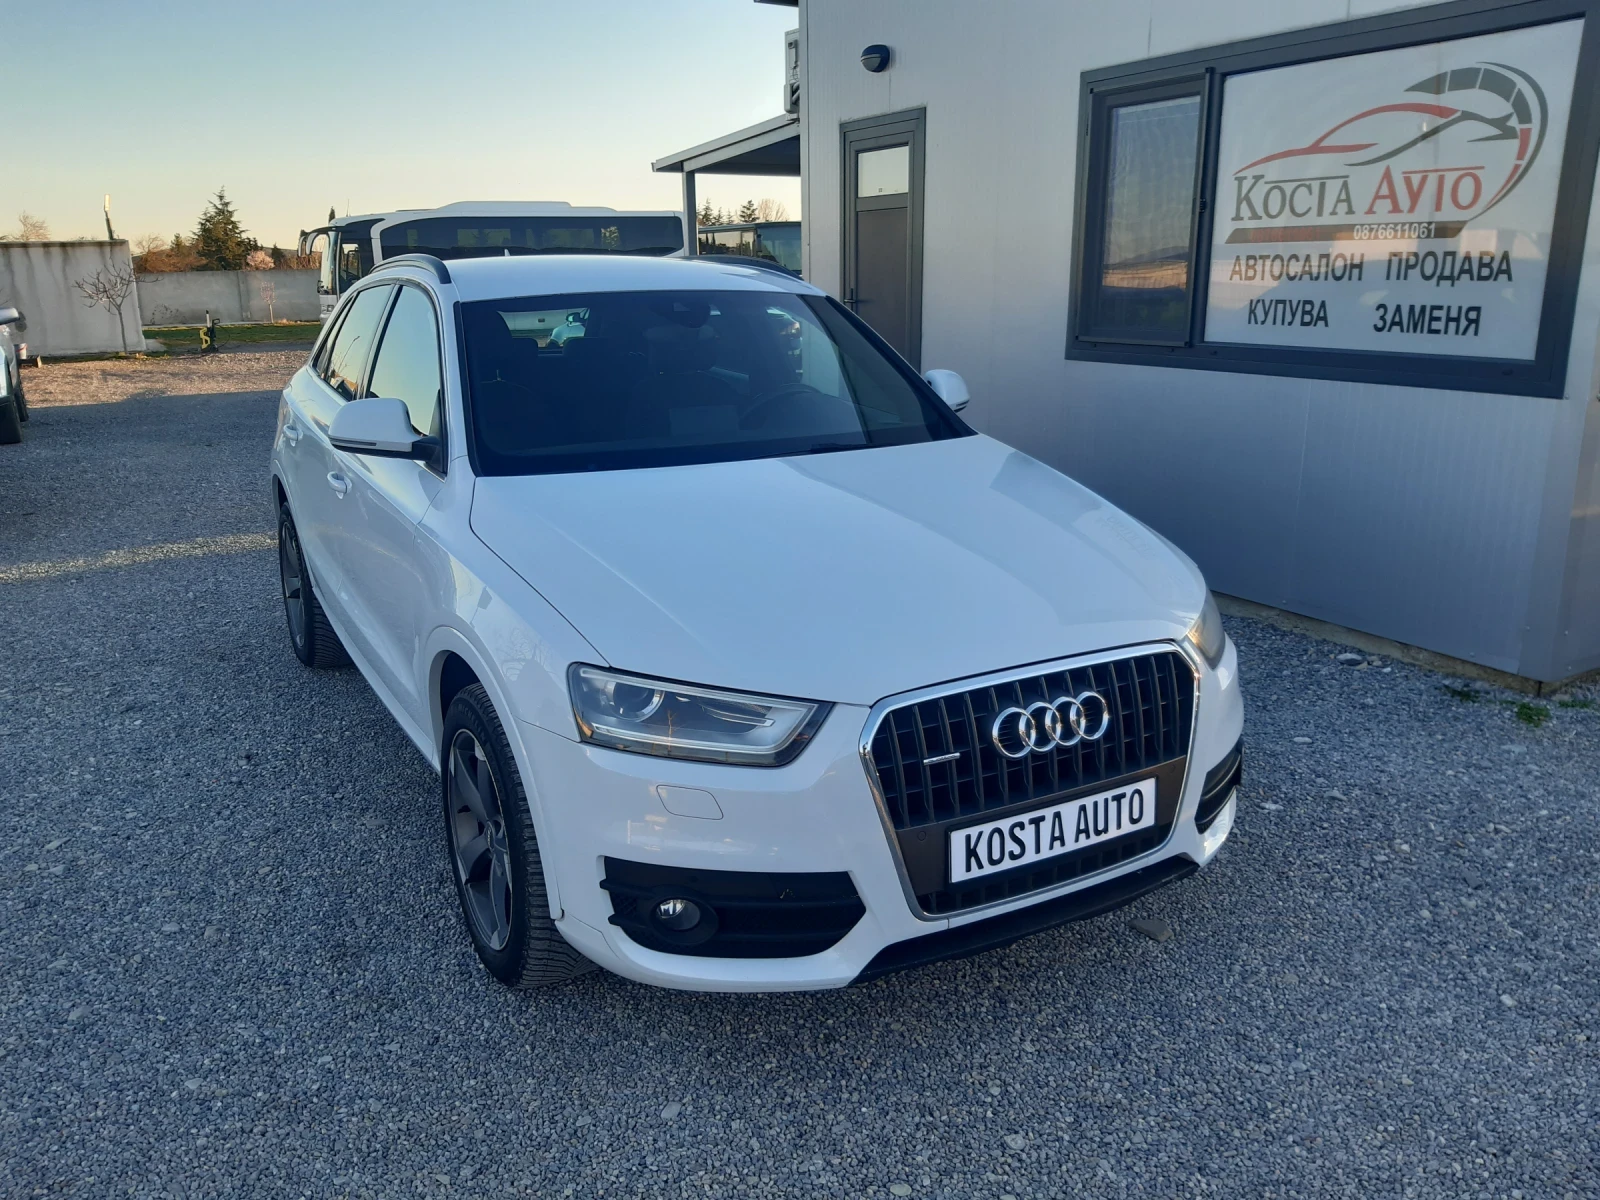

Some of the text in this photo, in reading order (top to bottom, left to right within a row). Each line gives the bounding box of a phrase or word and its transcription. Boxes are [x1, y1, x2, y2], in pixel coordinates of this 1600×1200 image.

[1353, 222, 1436, 240] 0876611061
[1229, 250, 1513, 287] АВТОСАЛОН ПРОДАВА
[1247, 299, 1482, 336] КУПУВА ЗАМЕНЯ
[964, 788, 1144, 873] KOSTA AUTO
